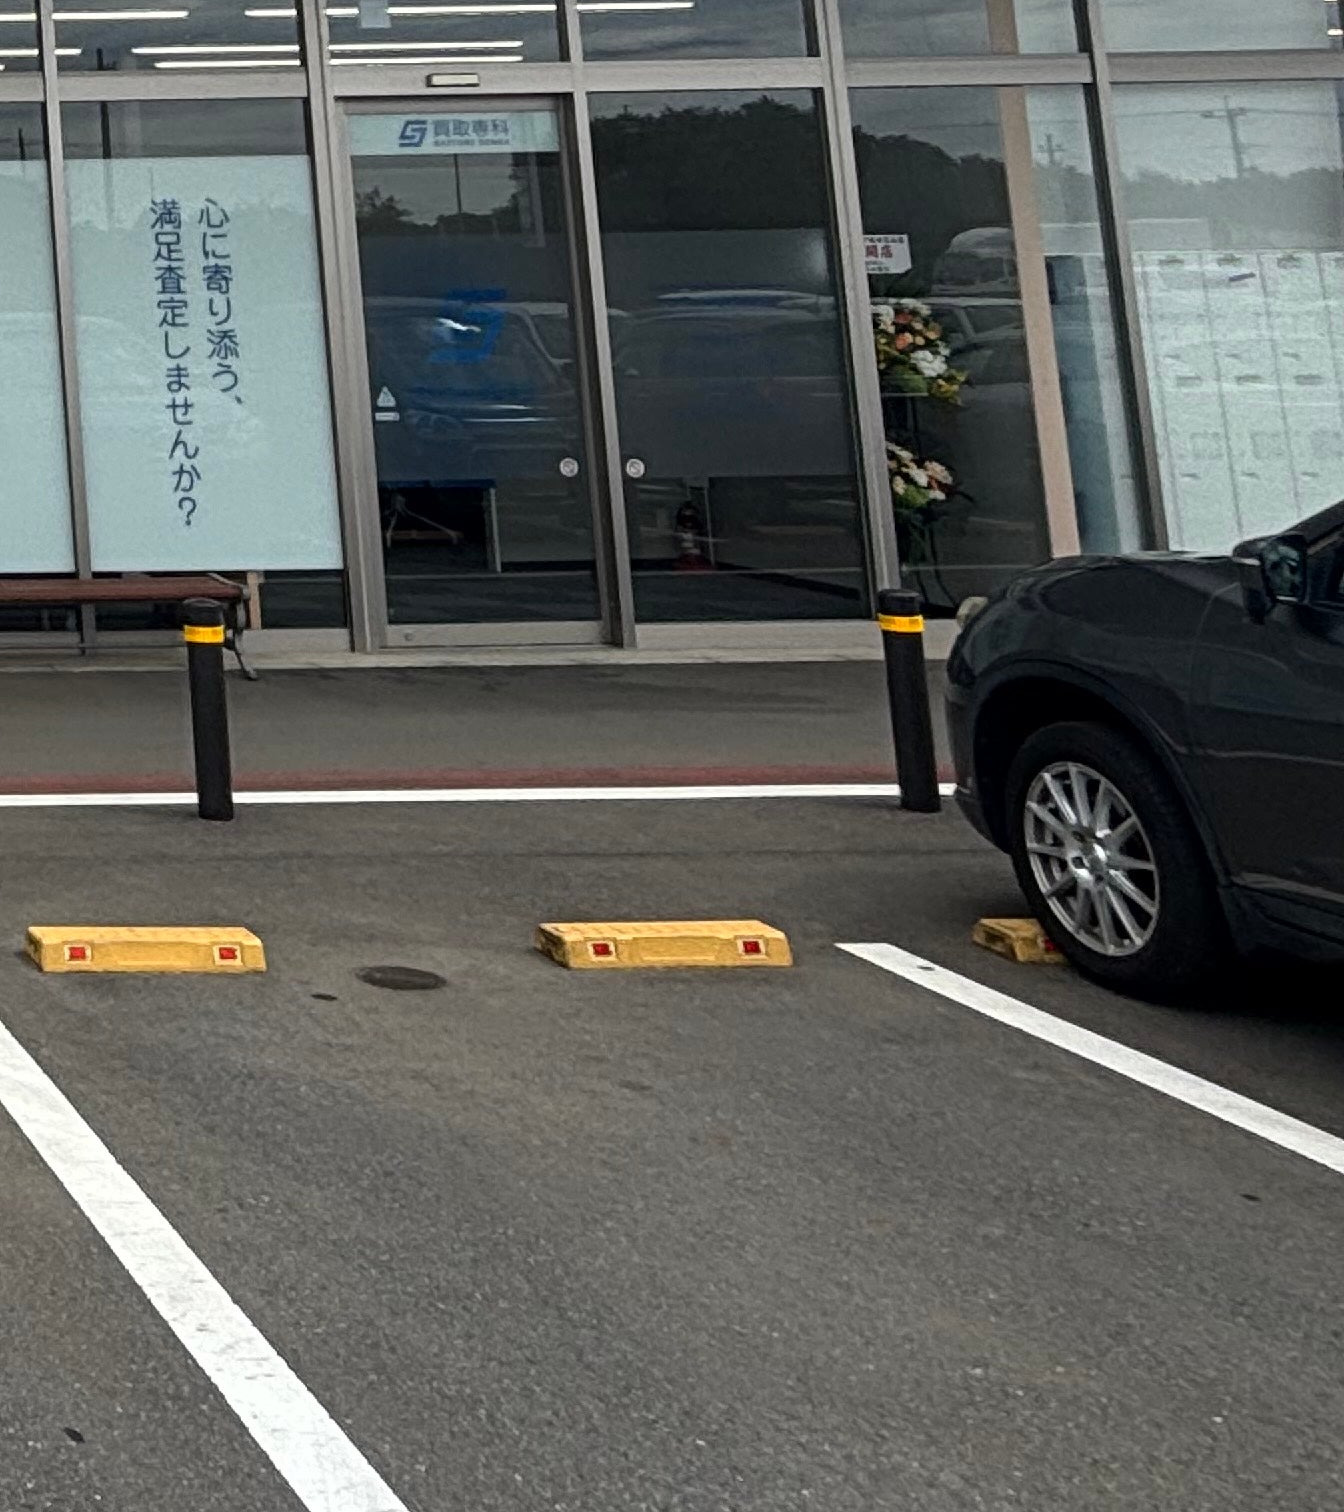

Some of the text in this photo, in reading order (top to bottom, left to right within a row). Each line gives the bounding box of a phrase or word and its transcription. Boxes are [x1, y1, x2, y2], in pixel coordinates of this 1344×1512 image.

[149, 198, 201, 527] 満足査定しませんか？
[198, 198, 243, 405] 心に寄り添う、
